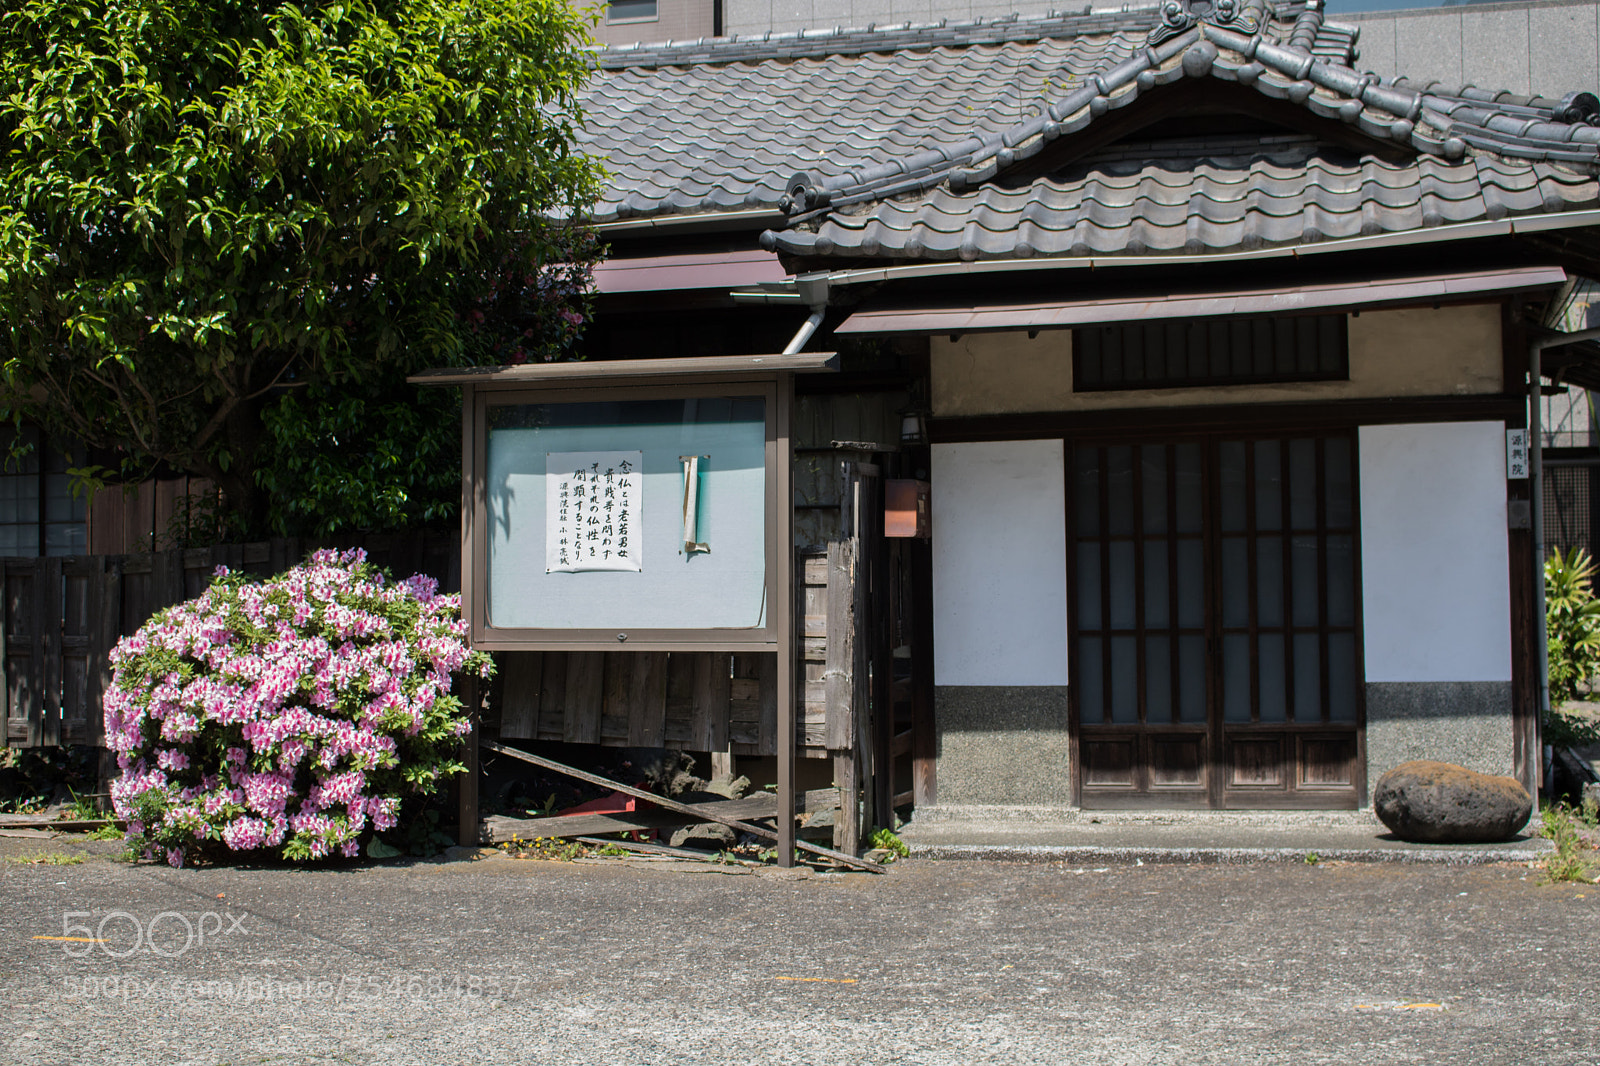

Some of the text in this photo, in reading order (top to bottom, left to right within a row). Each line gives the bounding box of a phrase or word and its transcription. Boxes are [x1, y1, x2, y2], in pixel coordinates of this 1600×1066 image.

[1511, 434, 1524, 475] 源興院
[617, 460, 633, 558] 念仏とは老若男女
